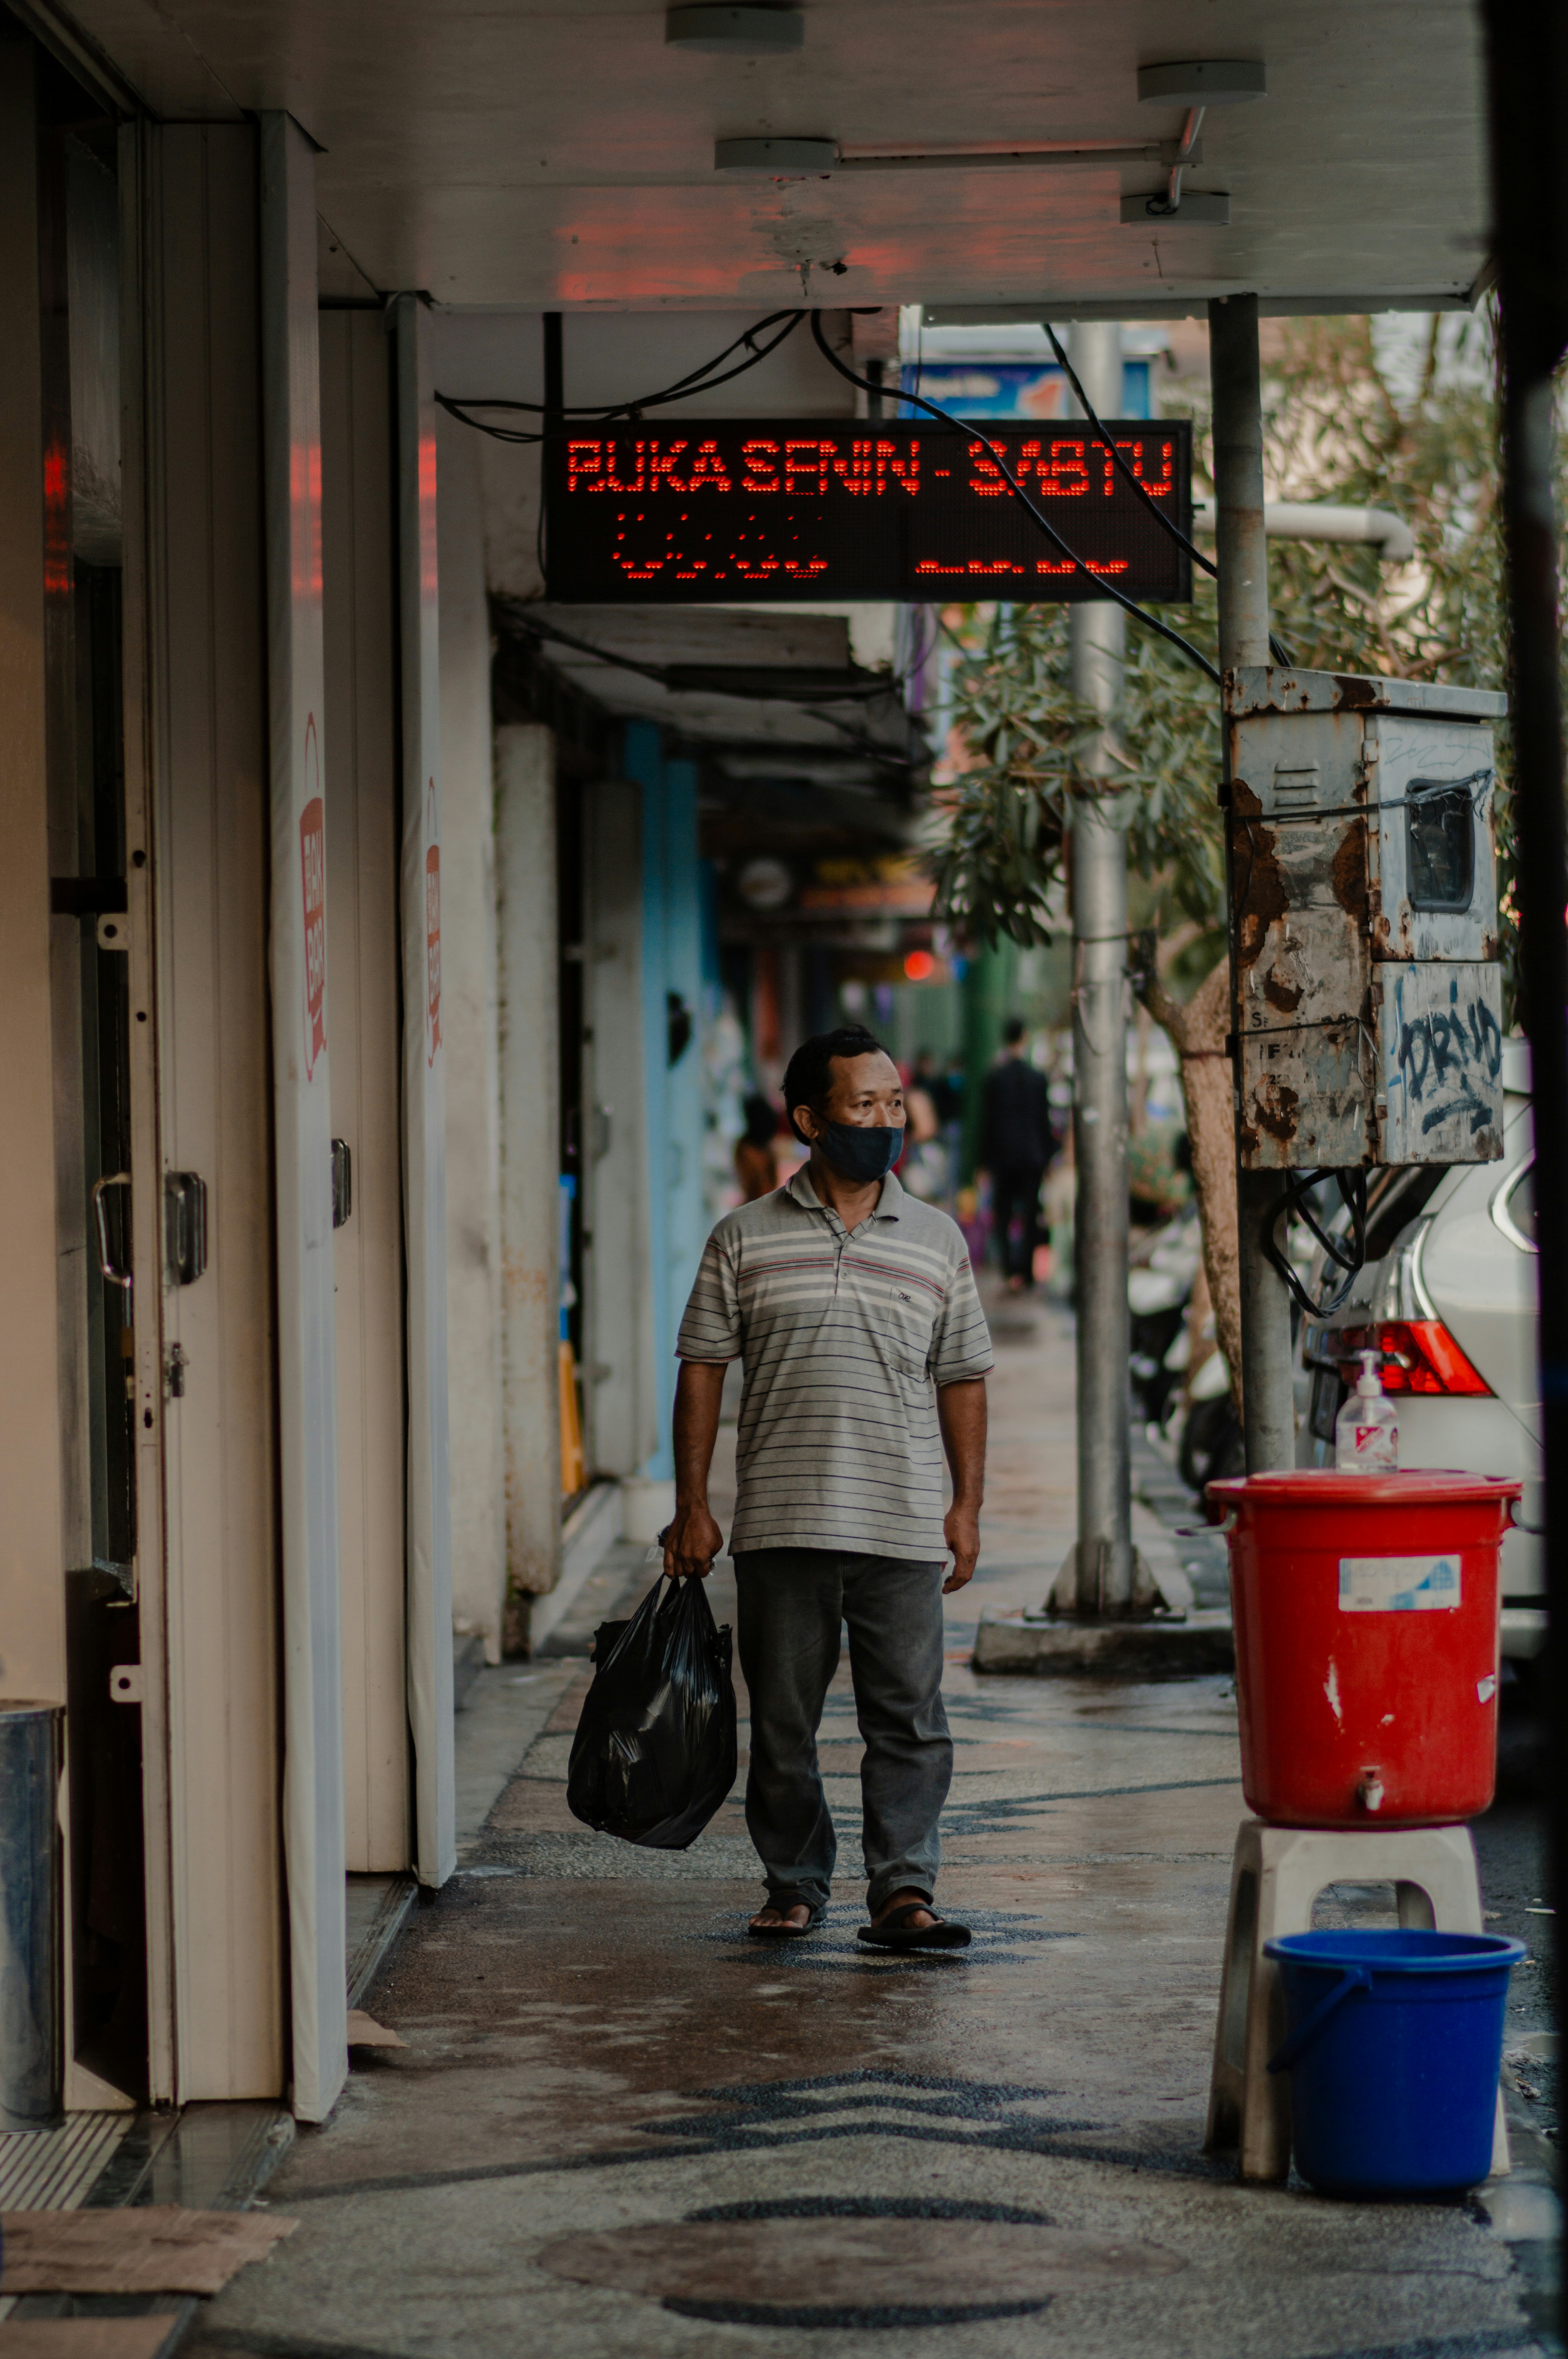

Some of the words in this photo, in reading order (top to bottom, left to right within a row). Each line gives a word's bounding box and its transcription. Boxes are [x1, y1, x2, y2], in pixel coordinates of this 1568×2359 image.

[568, 440, 731, 492] BUKA
[741, 440, 920, 496] SENIN
[968, 440, 1172, 496] SABTU
